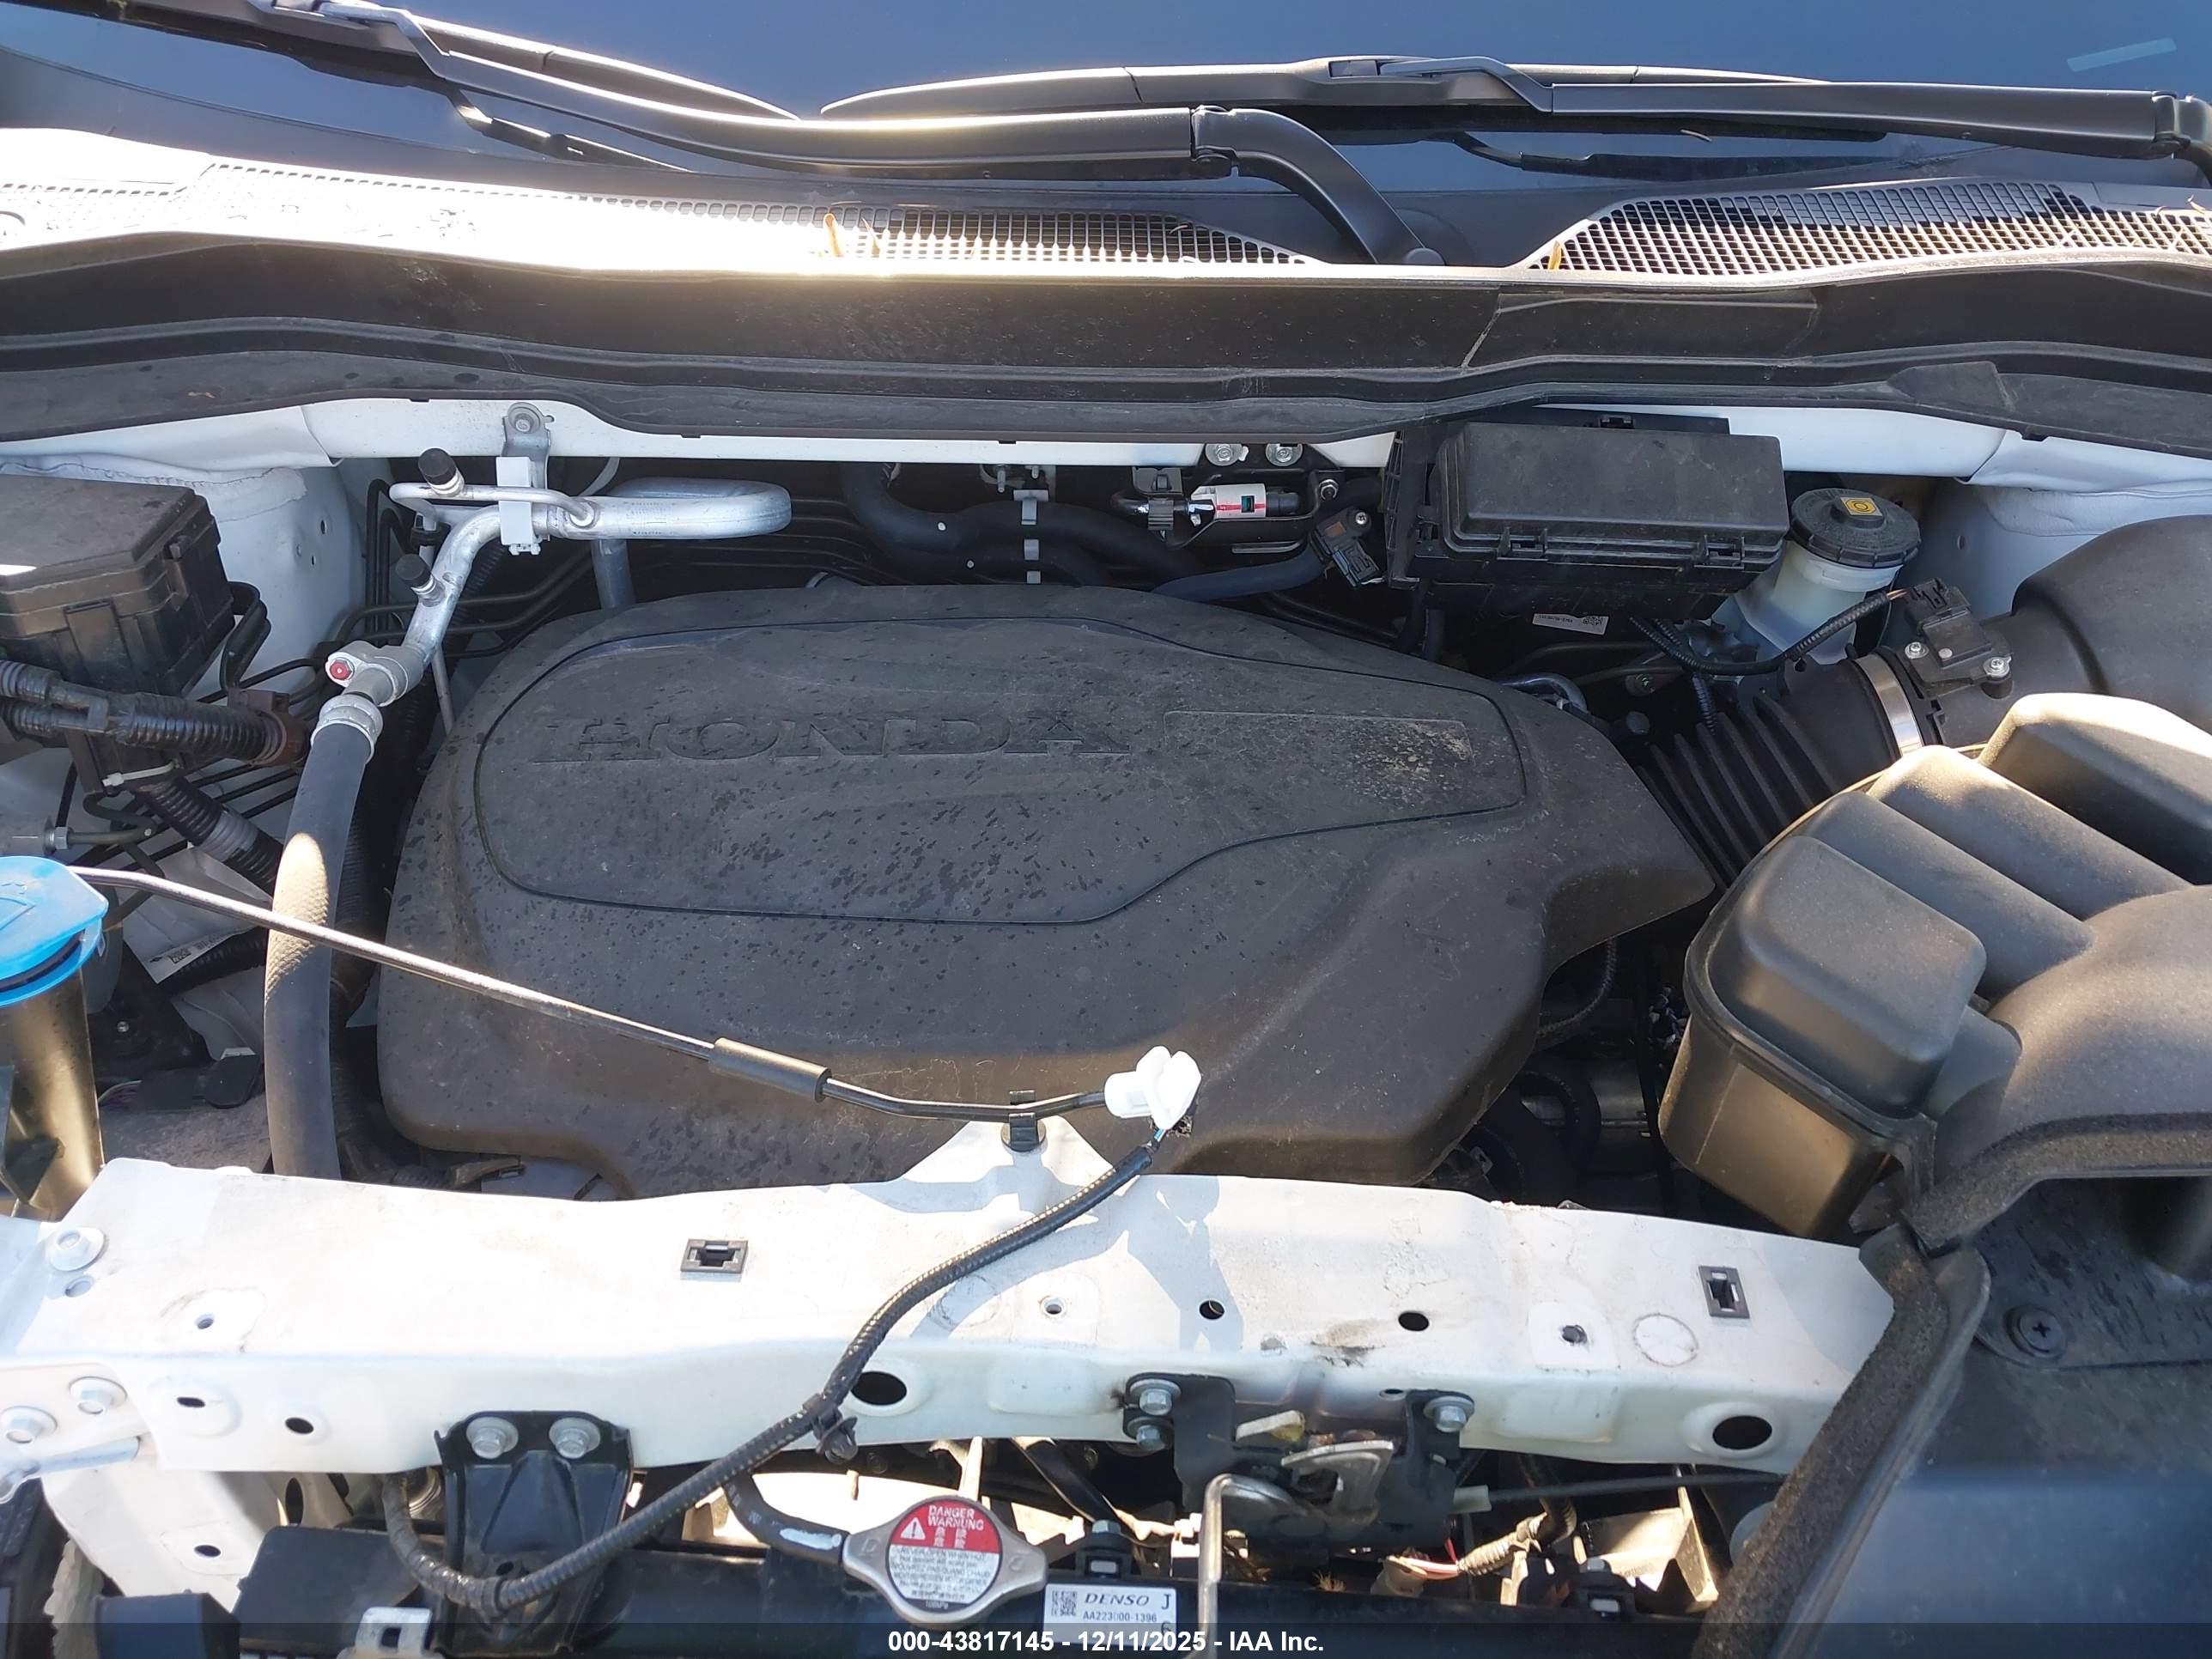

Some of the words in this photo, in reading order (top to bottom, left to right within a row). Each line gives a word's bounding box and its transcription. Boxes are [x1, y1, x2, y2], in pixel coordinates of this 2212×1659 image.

[531, 719, 1133, 763] HONDA
[928, 1504, 975, 1520] DANGER
[928, 1516, 984, 1531] WARNUNG
[1085, 1593, 1150, 1607] DENSO
[1161, 1593, 1172, 1610] J
